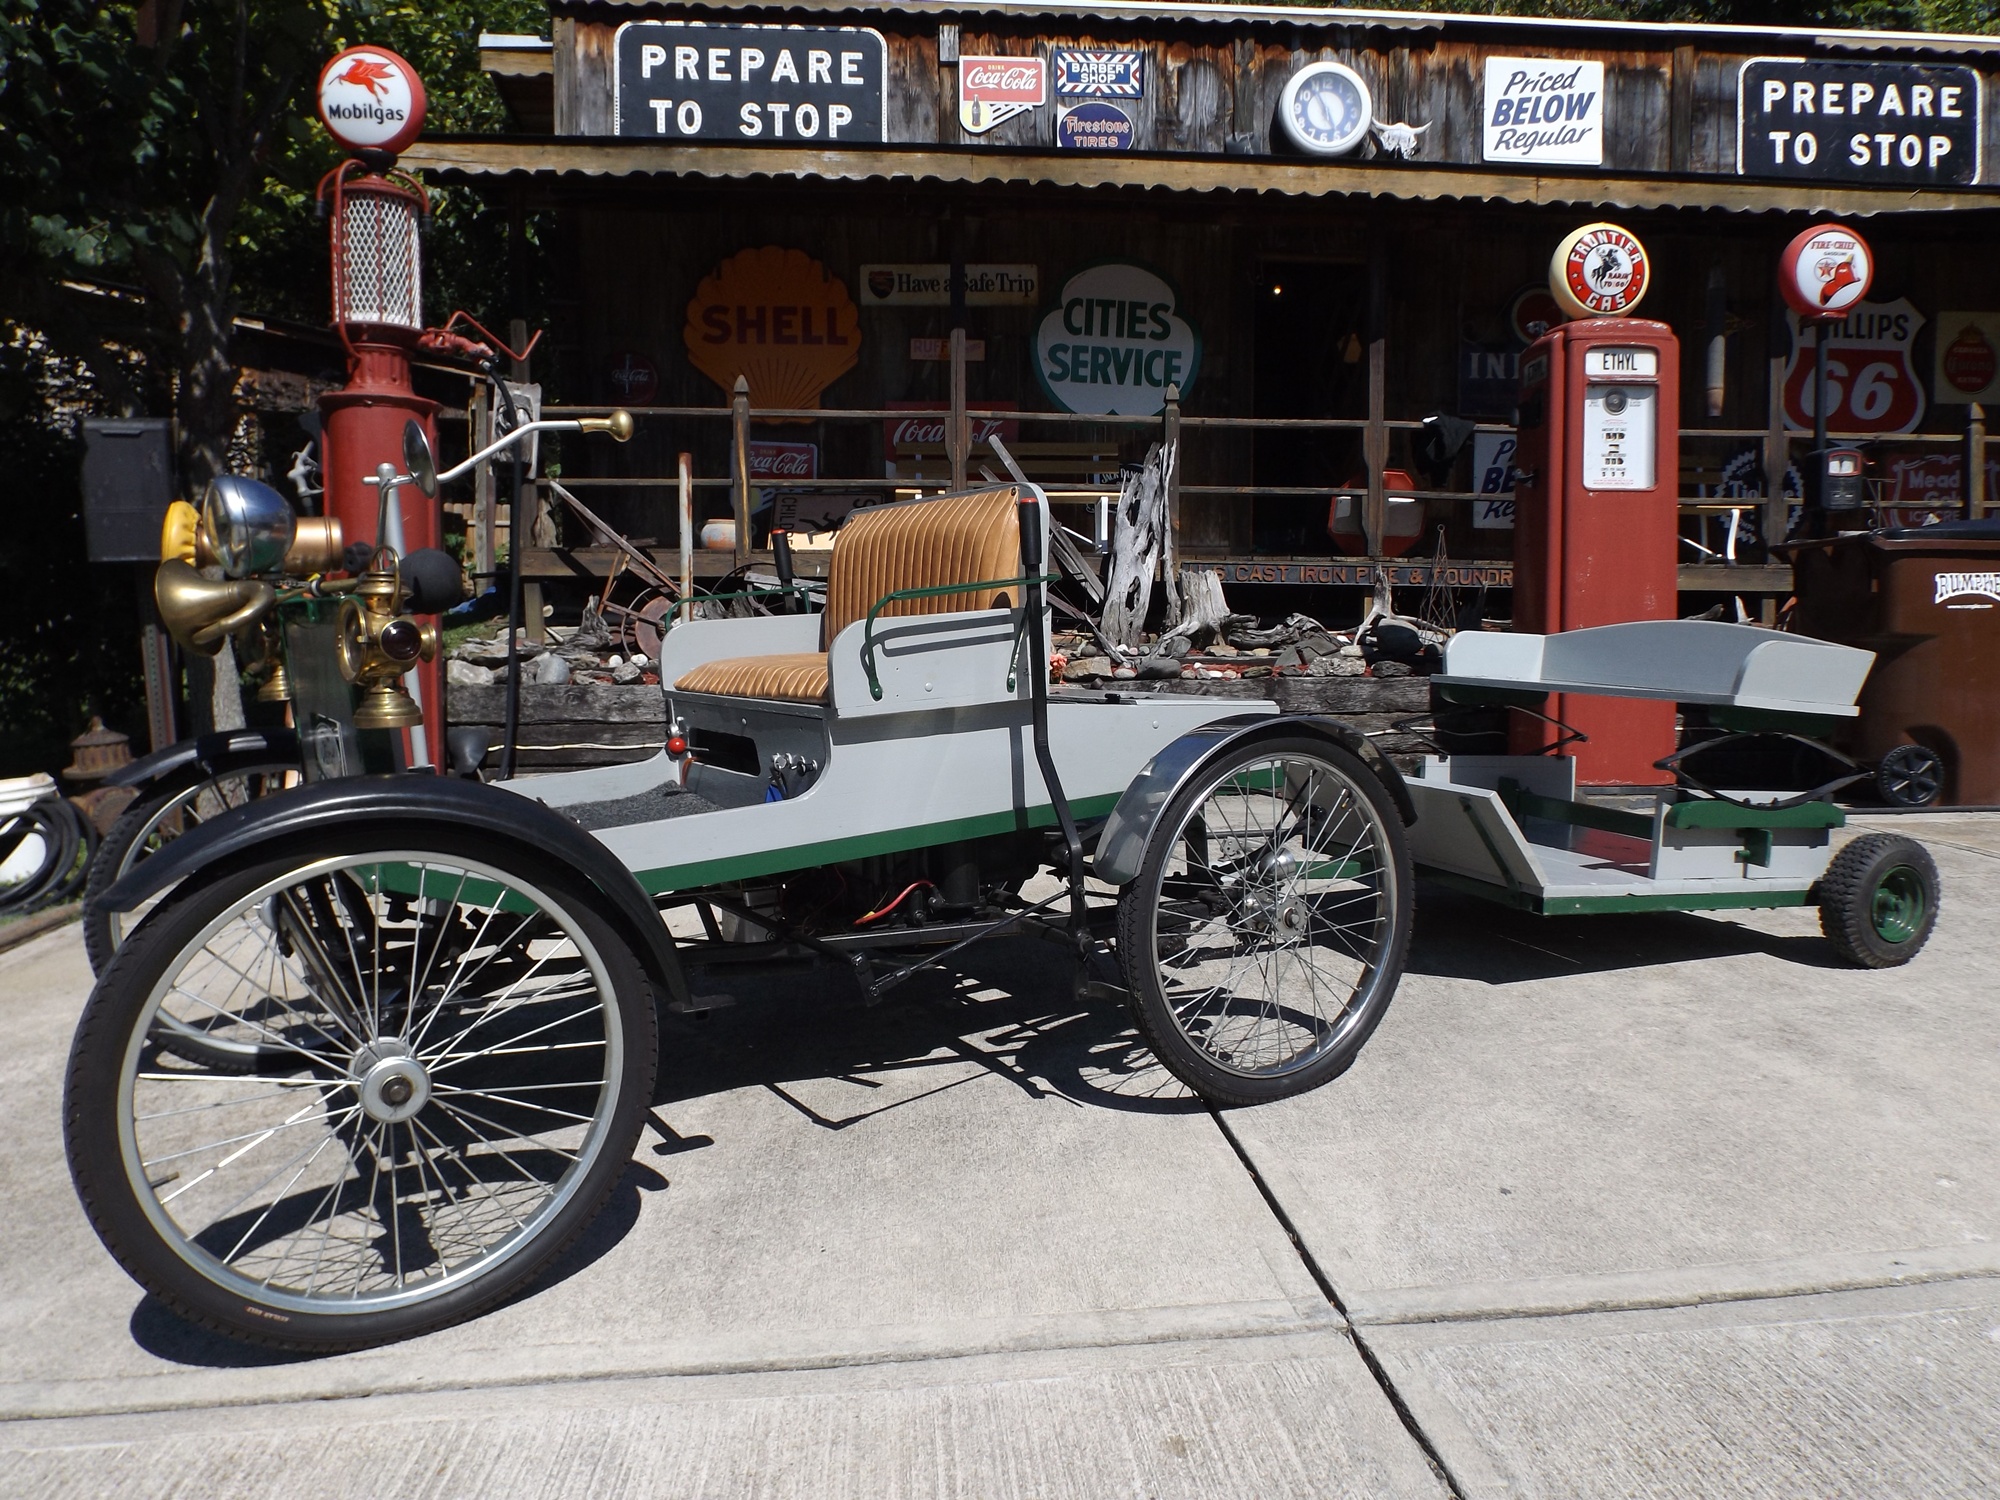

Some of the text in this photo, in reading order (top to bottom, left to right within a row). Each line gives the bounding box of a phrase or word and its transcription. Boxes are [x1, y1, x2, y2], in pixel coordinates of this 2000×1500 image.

[641, 44, 864, 85] PREPARE
[1071, 62, 1125, 74] BARBER
[1080, 73, 1116, 84] SHOP
[1502, 65, 1583, 97] Priced
[328, 103, 405, 125] Mobilgas
[1490, 91, 1596, 127] BELOW
[1762, 79, 1963, 118] PREPARE
[648, 99, 853, 139] TO STOP
[1063, 115, 1130, 135] Firestone
[1073, 136, 1119, 148] TIRES
[1493, 124, 1593, 156] Regular
[1768, 131, 1953, 168] TO STOP
[1569, 230, 1643, 265] FRONTIER
[897, 273, 941, 293] Have
[995, 273, 1035, 298] Trip
[1585, 292, 1627, 311] GAS
[702, 304, 849, 345] SHELL
[1063, 297, 1172, 341] CITIES
[1047, 343, 1182, 388] SERVICE
[1603, 353, 1638, 371] ETHYL
[1800, 360, 1900, 421] 66
[1235, 565, 1289, 582] CAST
[1300, 565, 1347, 583] IRON
[1355, 566, 1400, 584] PIE
[1409, 568, 1424, 584] &
